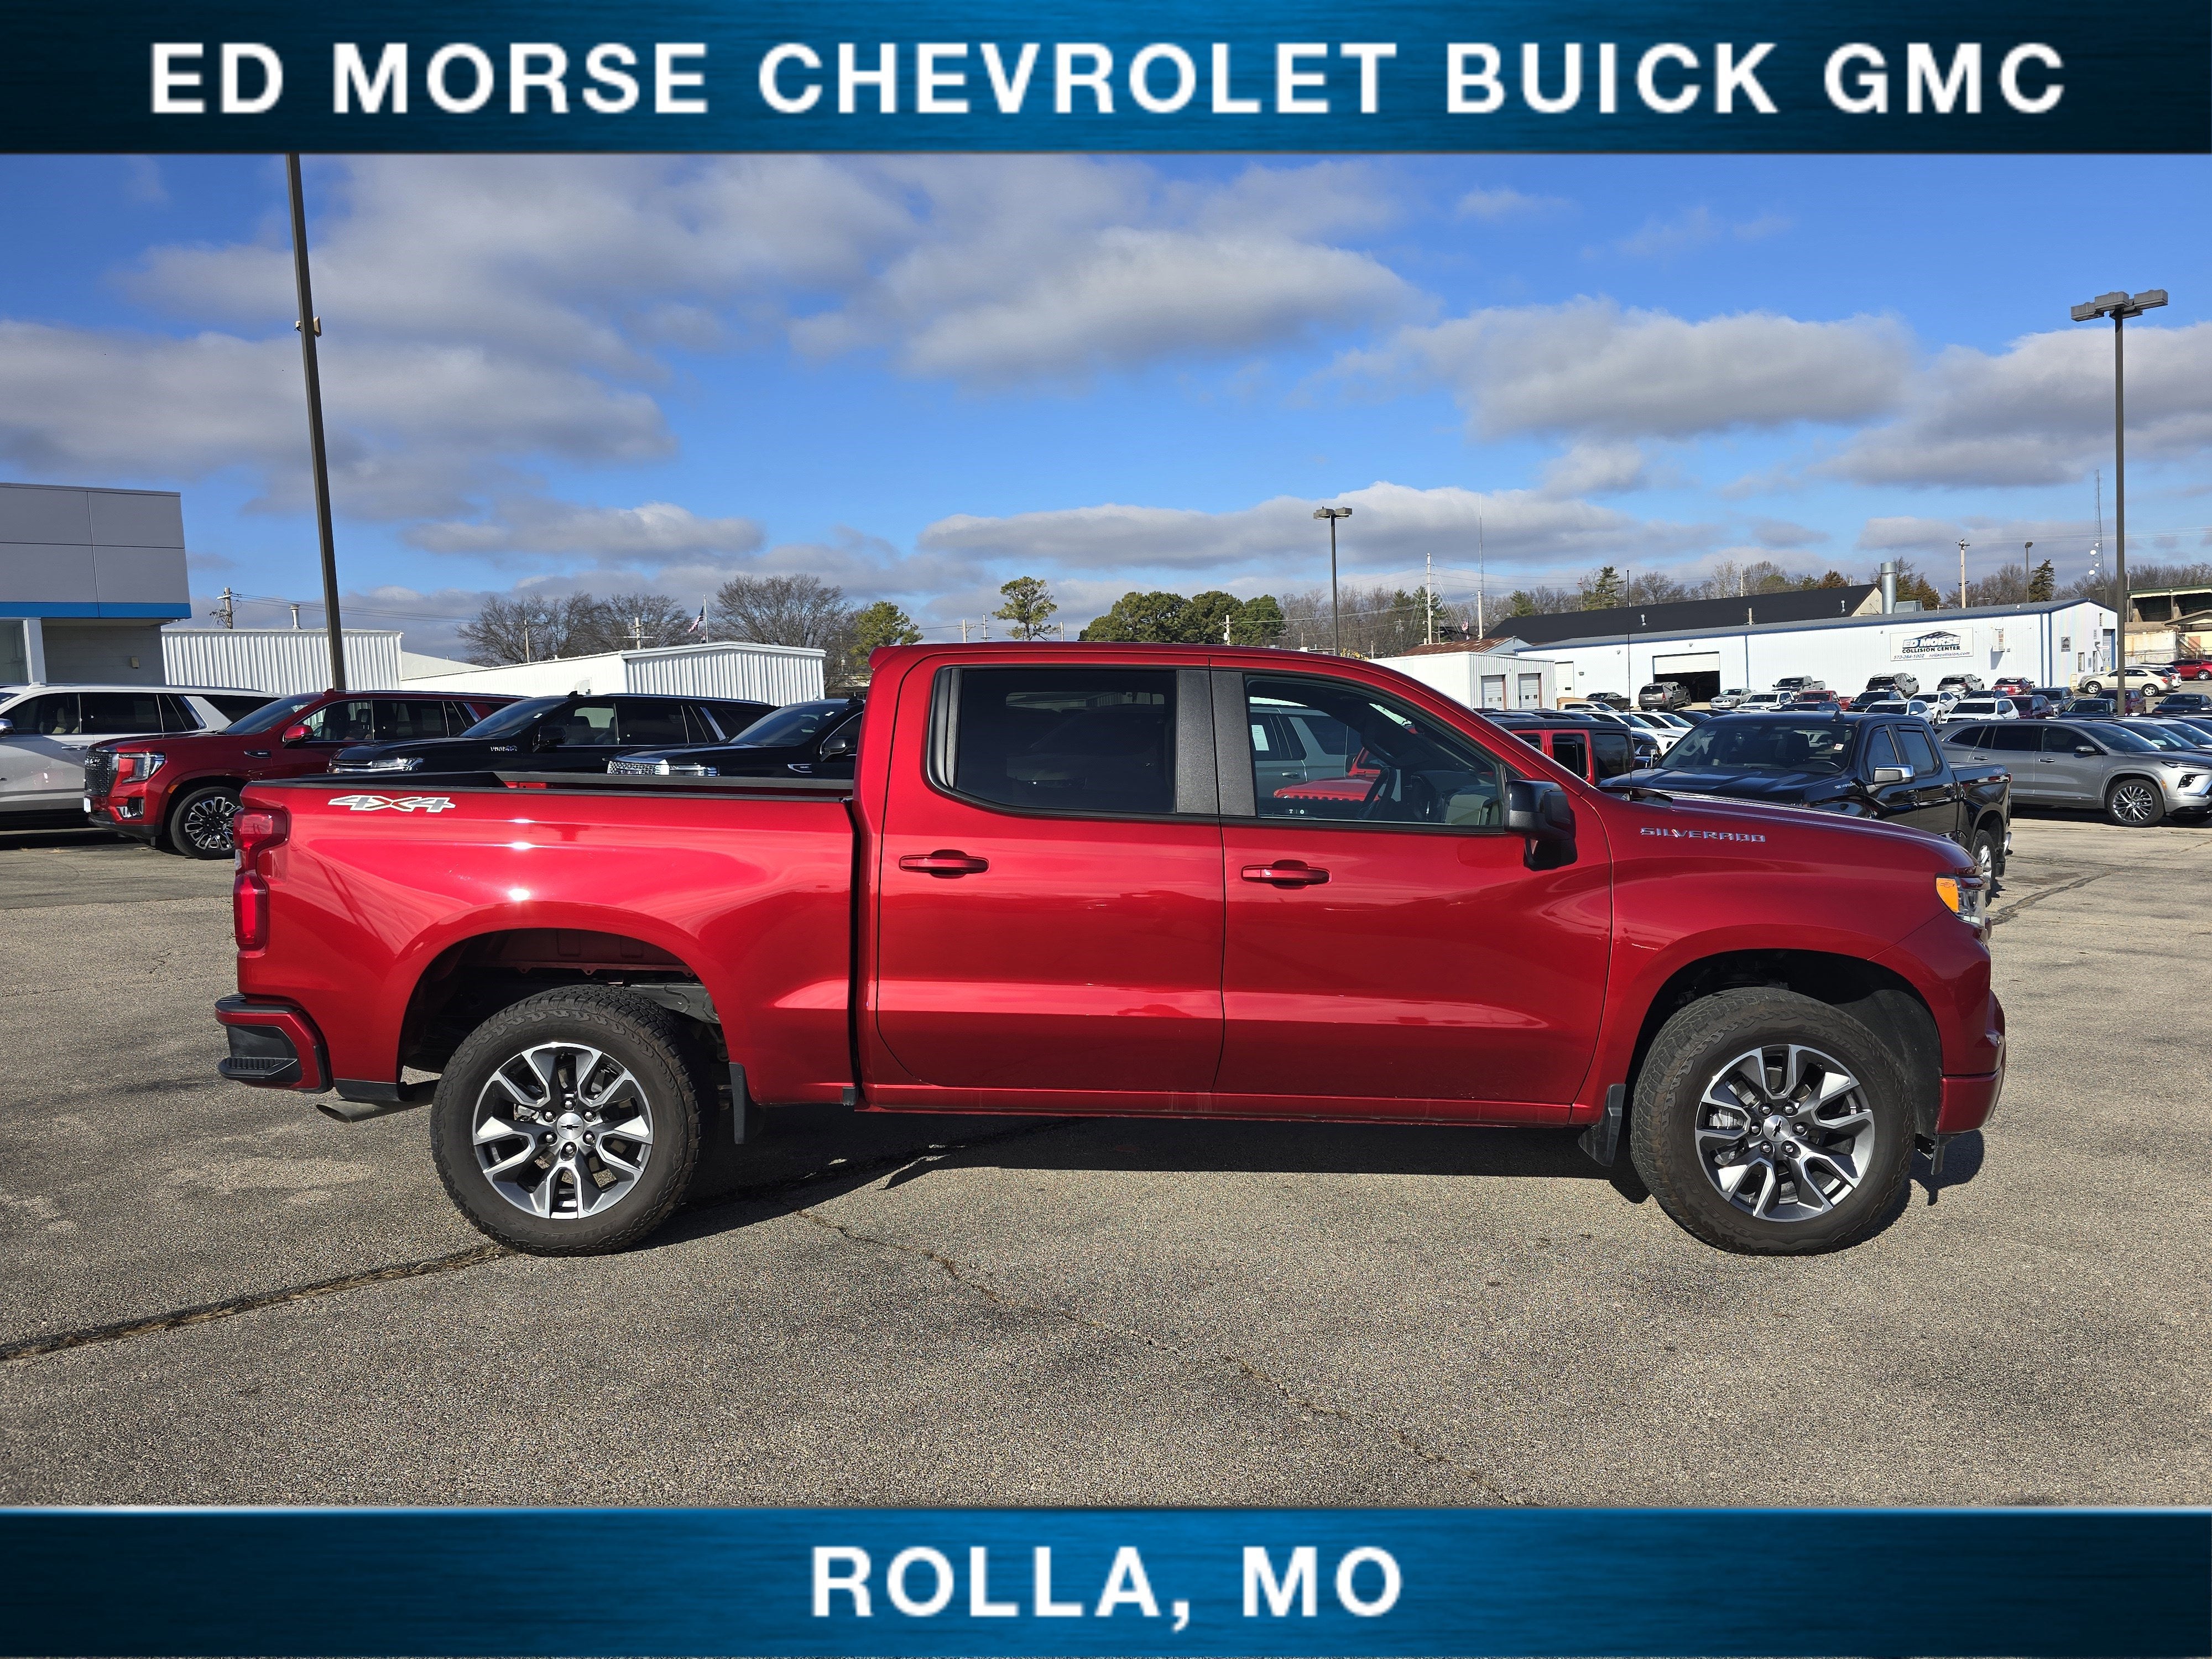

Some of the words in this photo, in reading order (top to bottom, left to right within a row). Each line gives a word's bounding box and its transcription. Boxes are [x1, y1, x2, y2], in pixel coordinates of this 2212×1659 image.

[1902, 640, 1919, 649] ED
[1919, 636, 1961, 648] MORSE
[1640, 827, 1766, 843] SILVERADO
